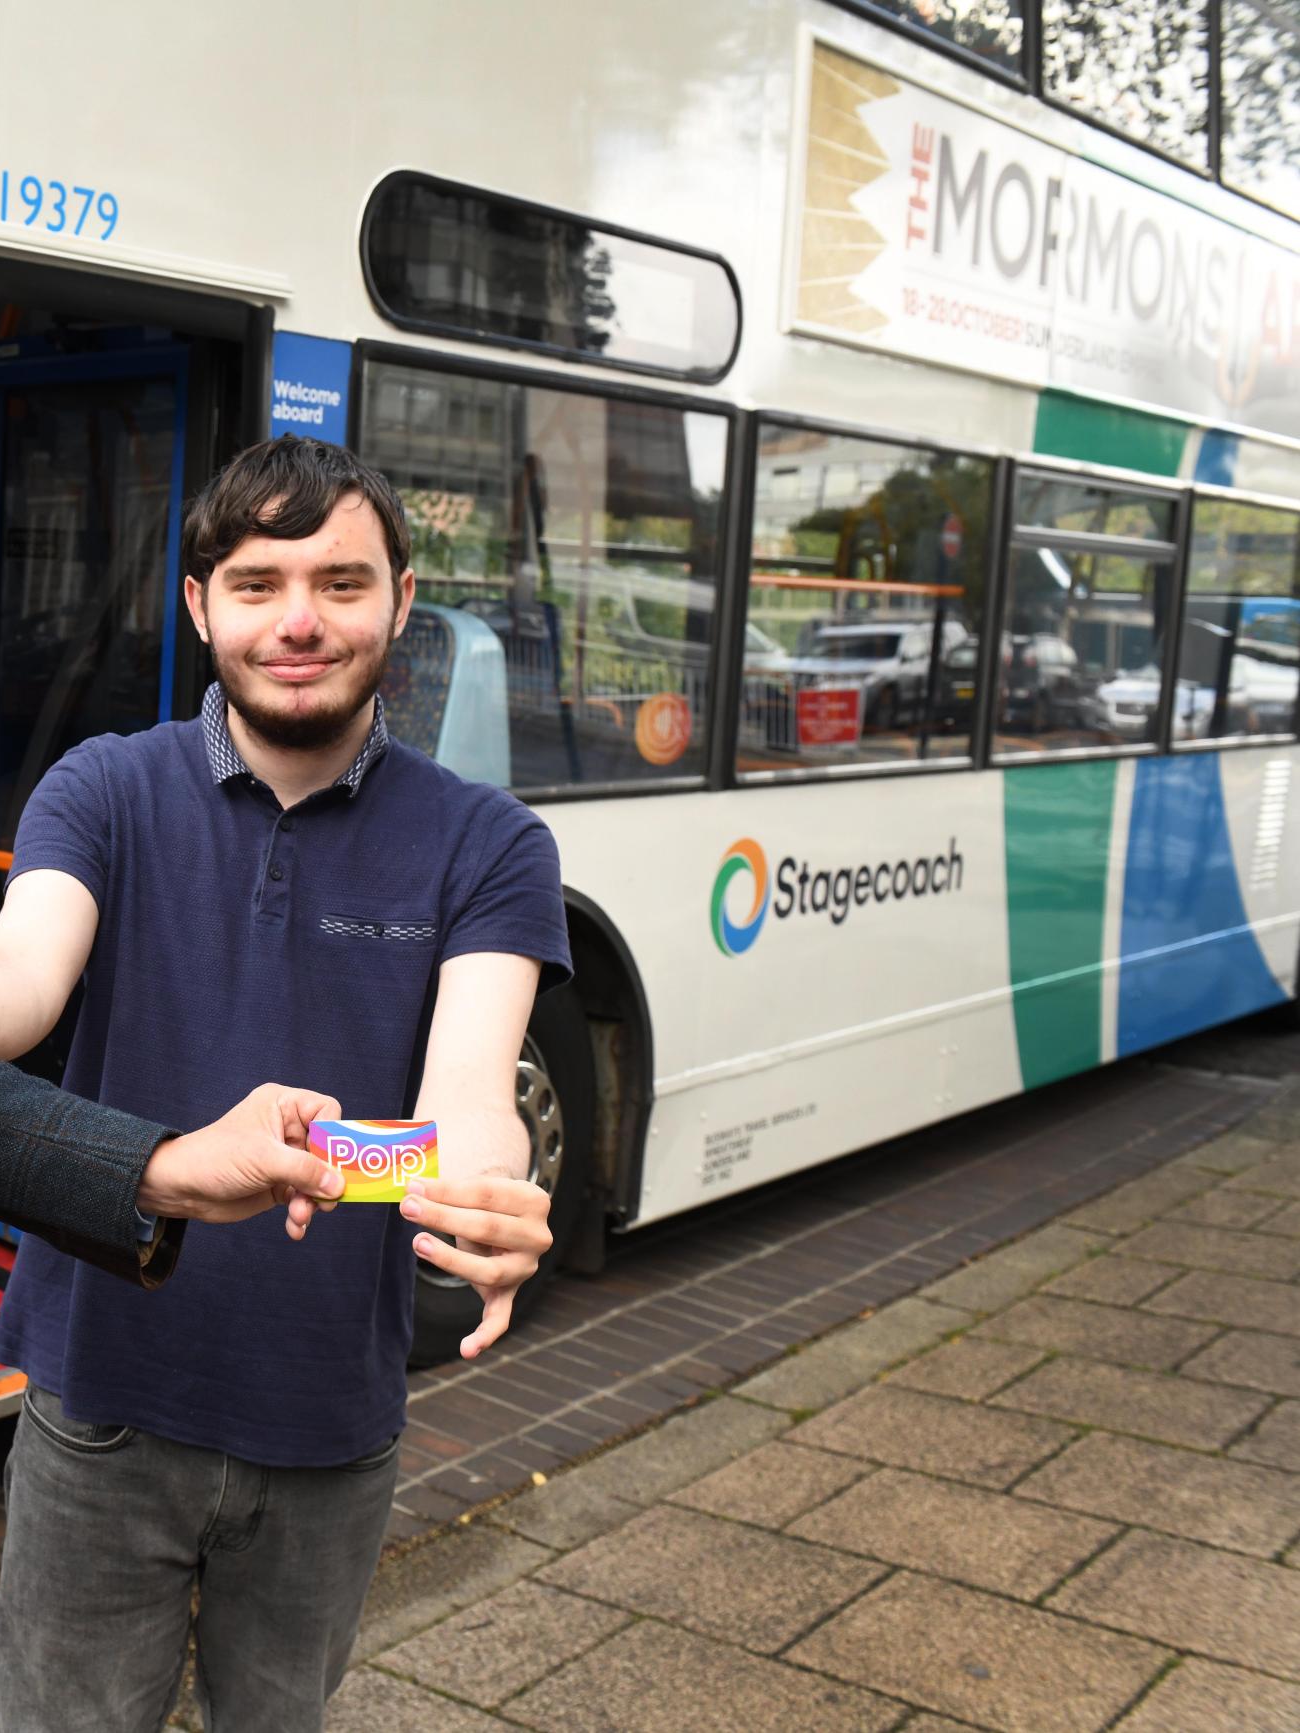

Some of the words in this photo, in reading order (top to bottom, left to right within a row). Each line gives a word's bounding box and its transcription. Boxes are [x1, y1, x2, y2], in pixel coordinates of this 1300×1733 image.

[0, 168, 120, 241] 19379
[905, 121, 936, 250] THE
[949, 300, 1023, 343] OCTOBER
[272, 400, 325, 425] aboard
[273, 379, 341, 407] Welcome
[772, 836, 965, 926] Stagecoach
[326, 1135, 427, 1187] Pop
